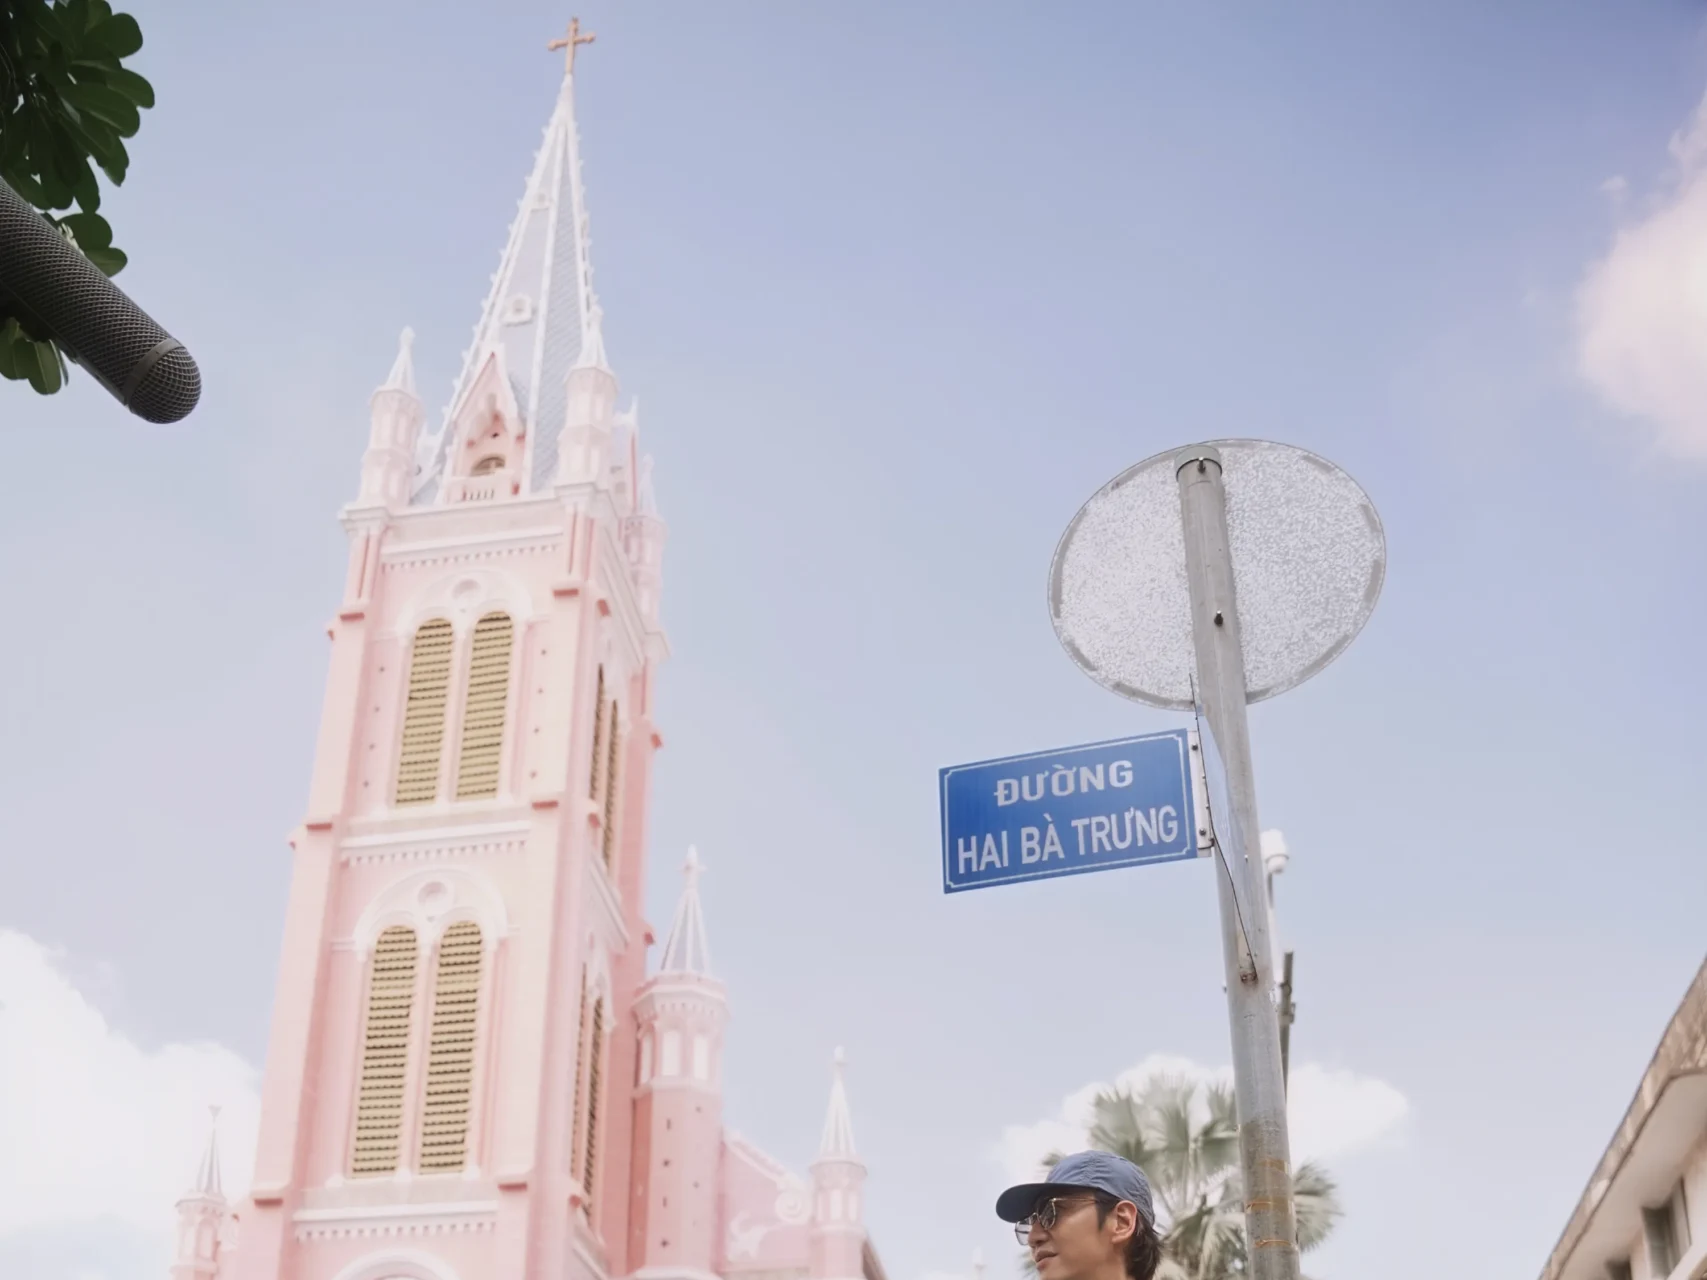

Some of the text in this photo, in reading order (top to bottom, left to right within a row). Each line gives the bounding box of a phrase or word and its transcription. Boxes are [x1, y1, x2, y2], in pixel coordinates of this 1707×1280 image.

[994, 760, 1133, 807] ĐƯỜNG
[957, 805, 1179, 874] HAI BÀ TRƯNG
